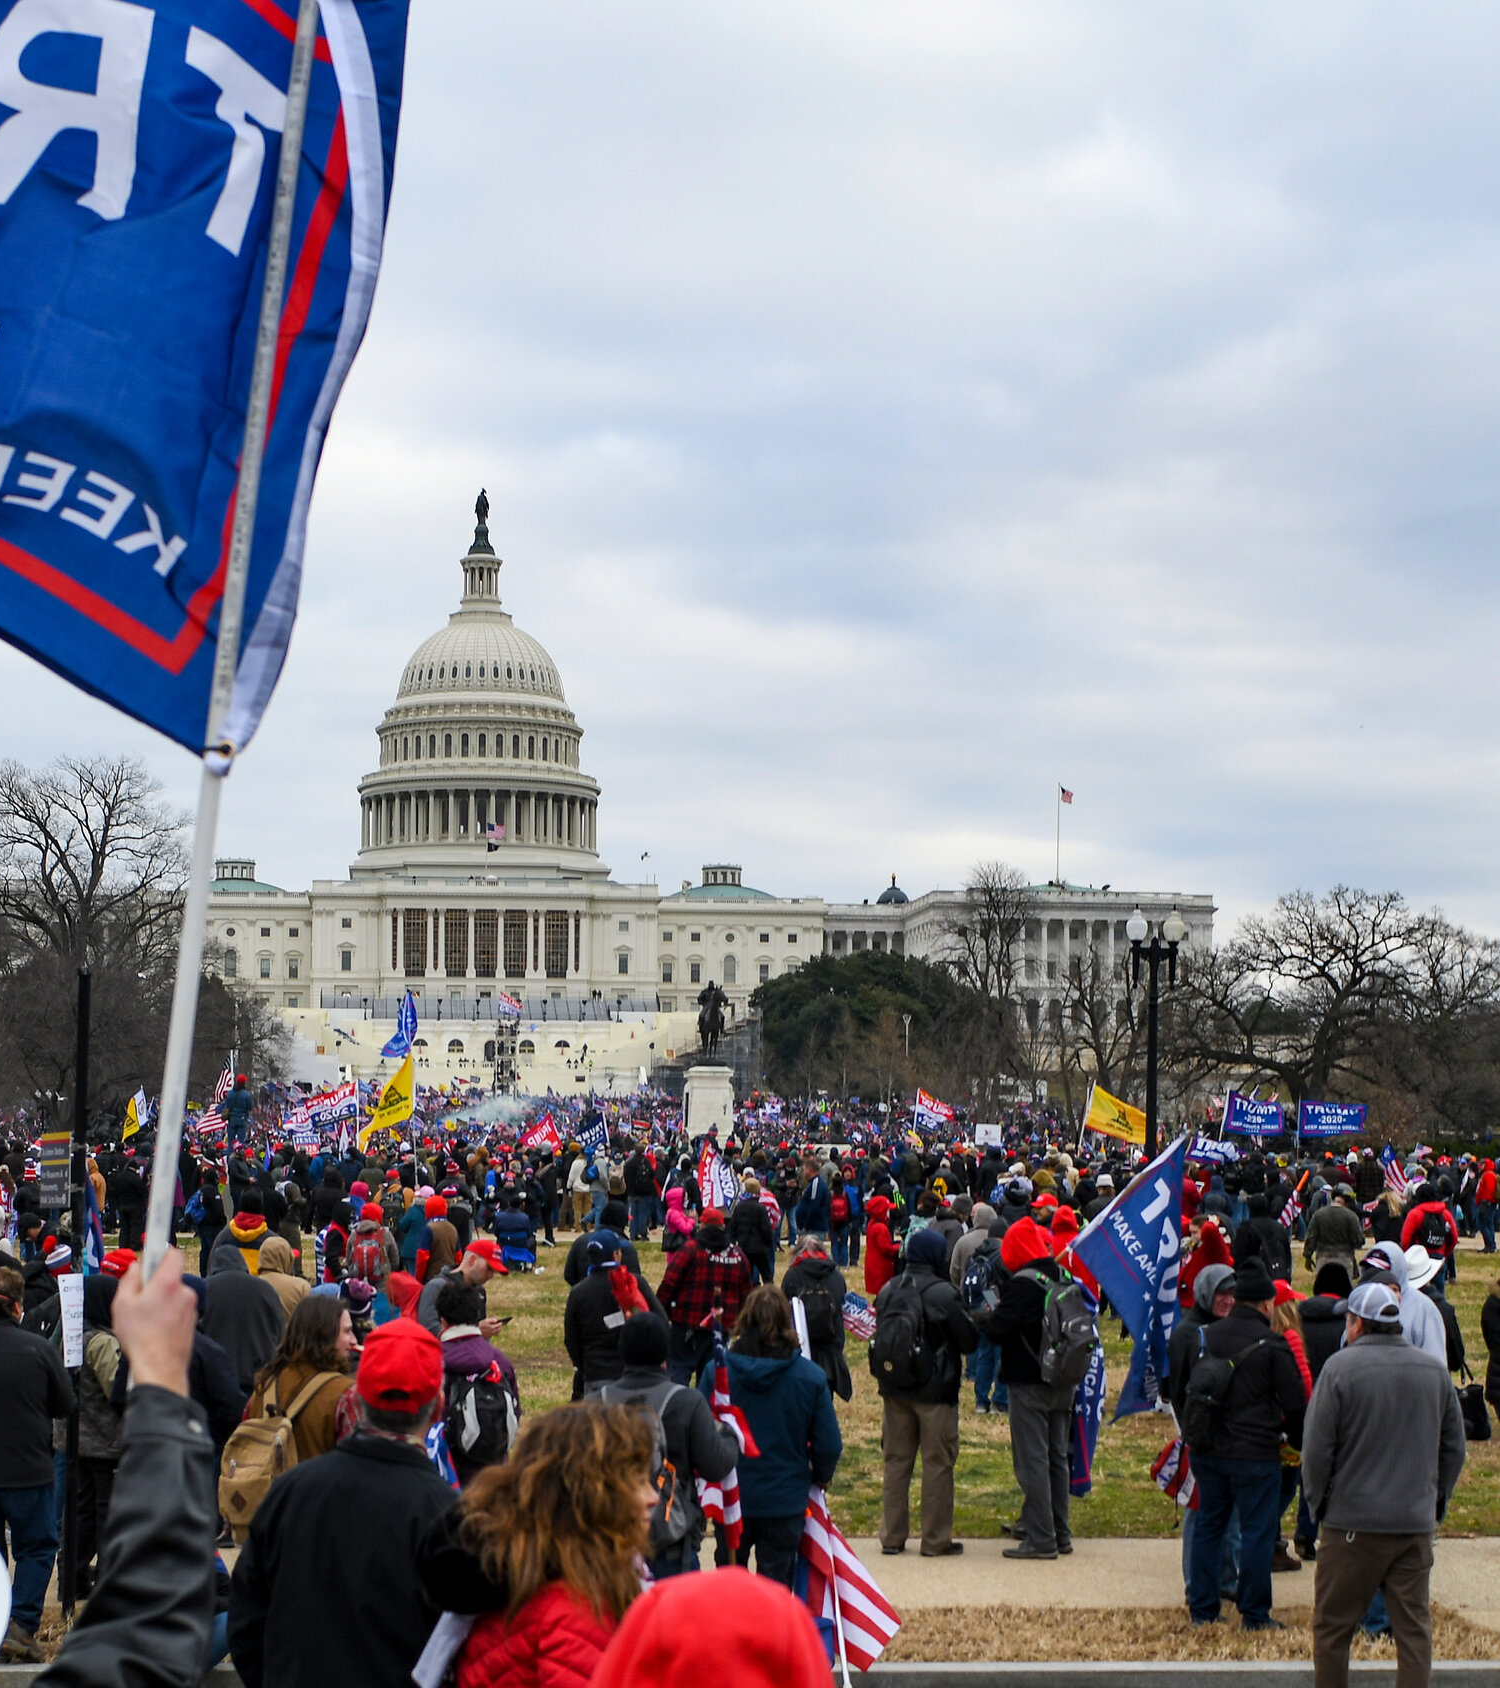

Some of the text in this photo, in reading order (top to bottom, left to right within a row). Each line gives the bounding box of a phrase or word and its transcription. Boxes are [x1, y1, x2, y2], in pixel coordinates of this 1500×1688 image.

[1235, 1097, 1277, 1115] TRUMP
[1306, 1104, 1359, 1116] TRUMP
[1108, 1209, 1142, 1256] MAKE
